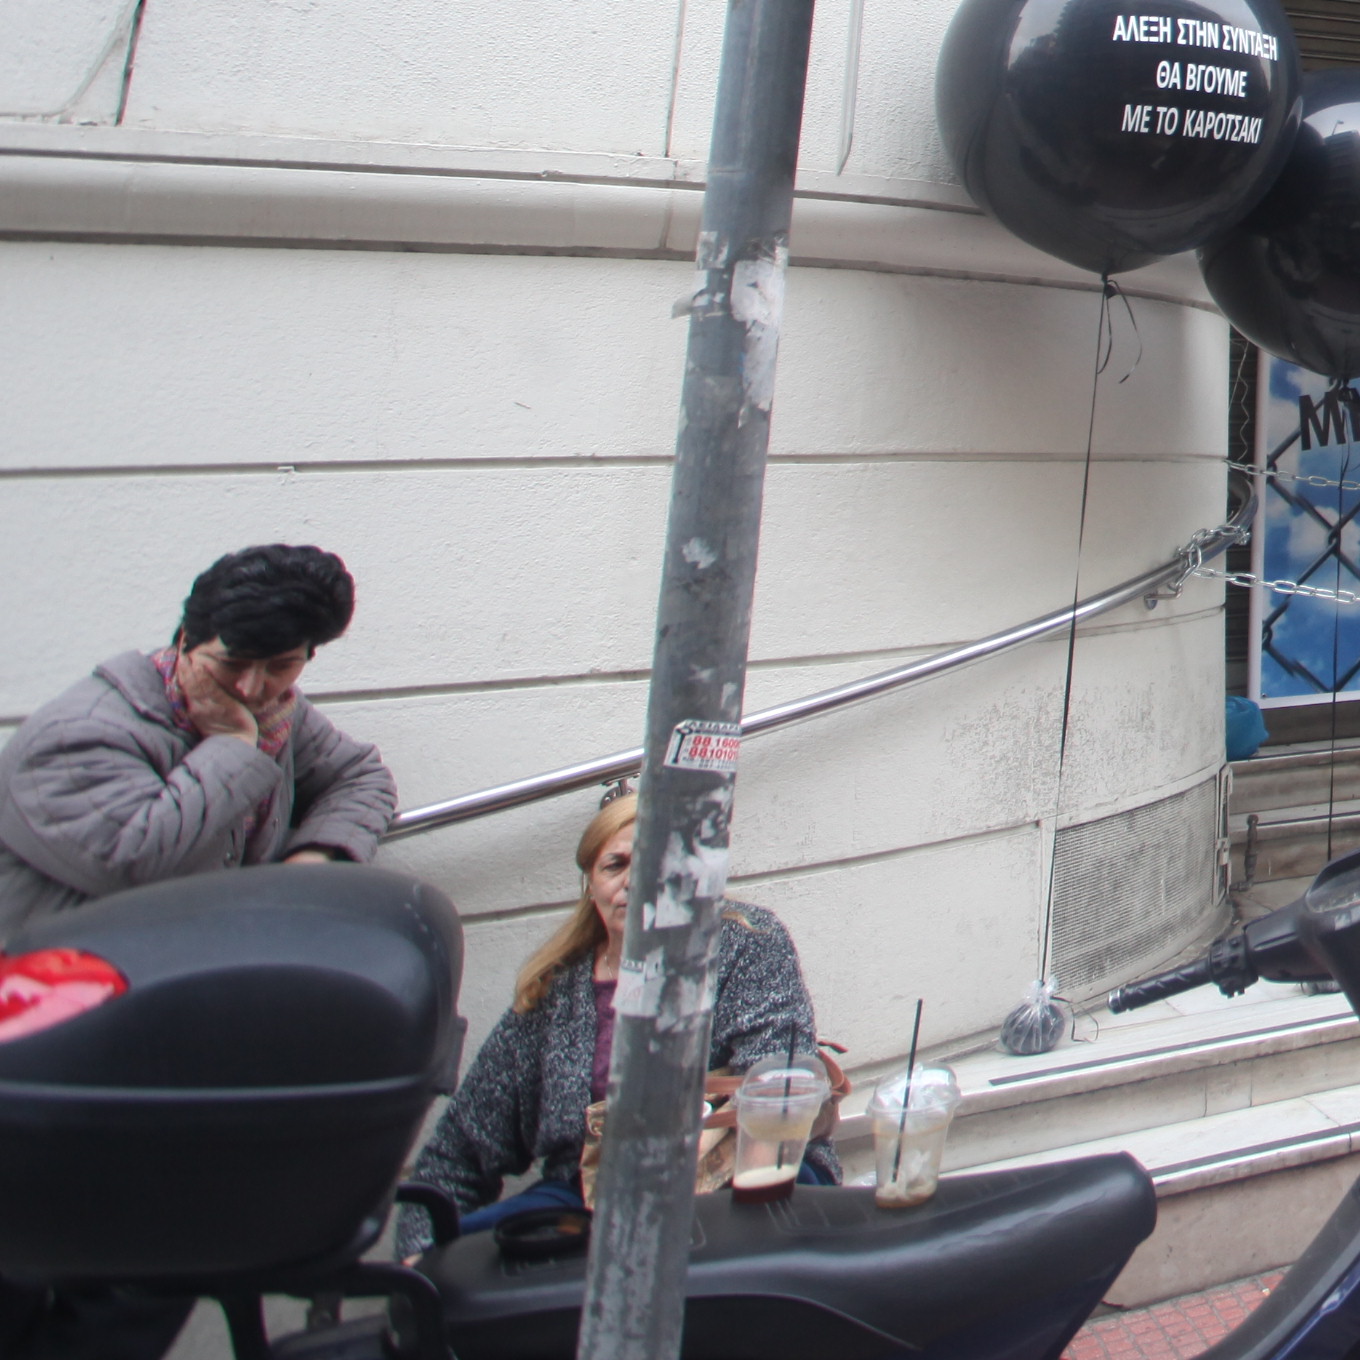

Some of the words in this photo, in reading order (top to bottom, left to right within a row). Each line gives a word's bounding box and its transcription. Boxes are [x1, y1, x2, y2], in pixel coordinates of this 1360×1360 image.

[1112, 15, 1171, 43] ΑΛΕΞΗ
[1177, 18, 1219, 49] ΣΤΗΝ
[1222, 24, 1278, 61] ΣΥΝΤΑΞΗ
[1156, 60, 1181, 90] ΘΑ
[1185, 63, 1247, 97] ΒΓΟΥΜΕ
[1121, 104, 1152, 133] ΜΕ
[1156, 106, 1179, 136] ΤΟ
[1182, 109, 1263, 144] ΚΑΡΟΤΣΑΚΙ
